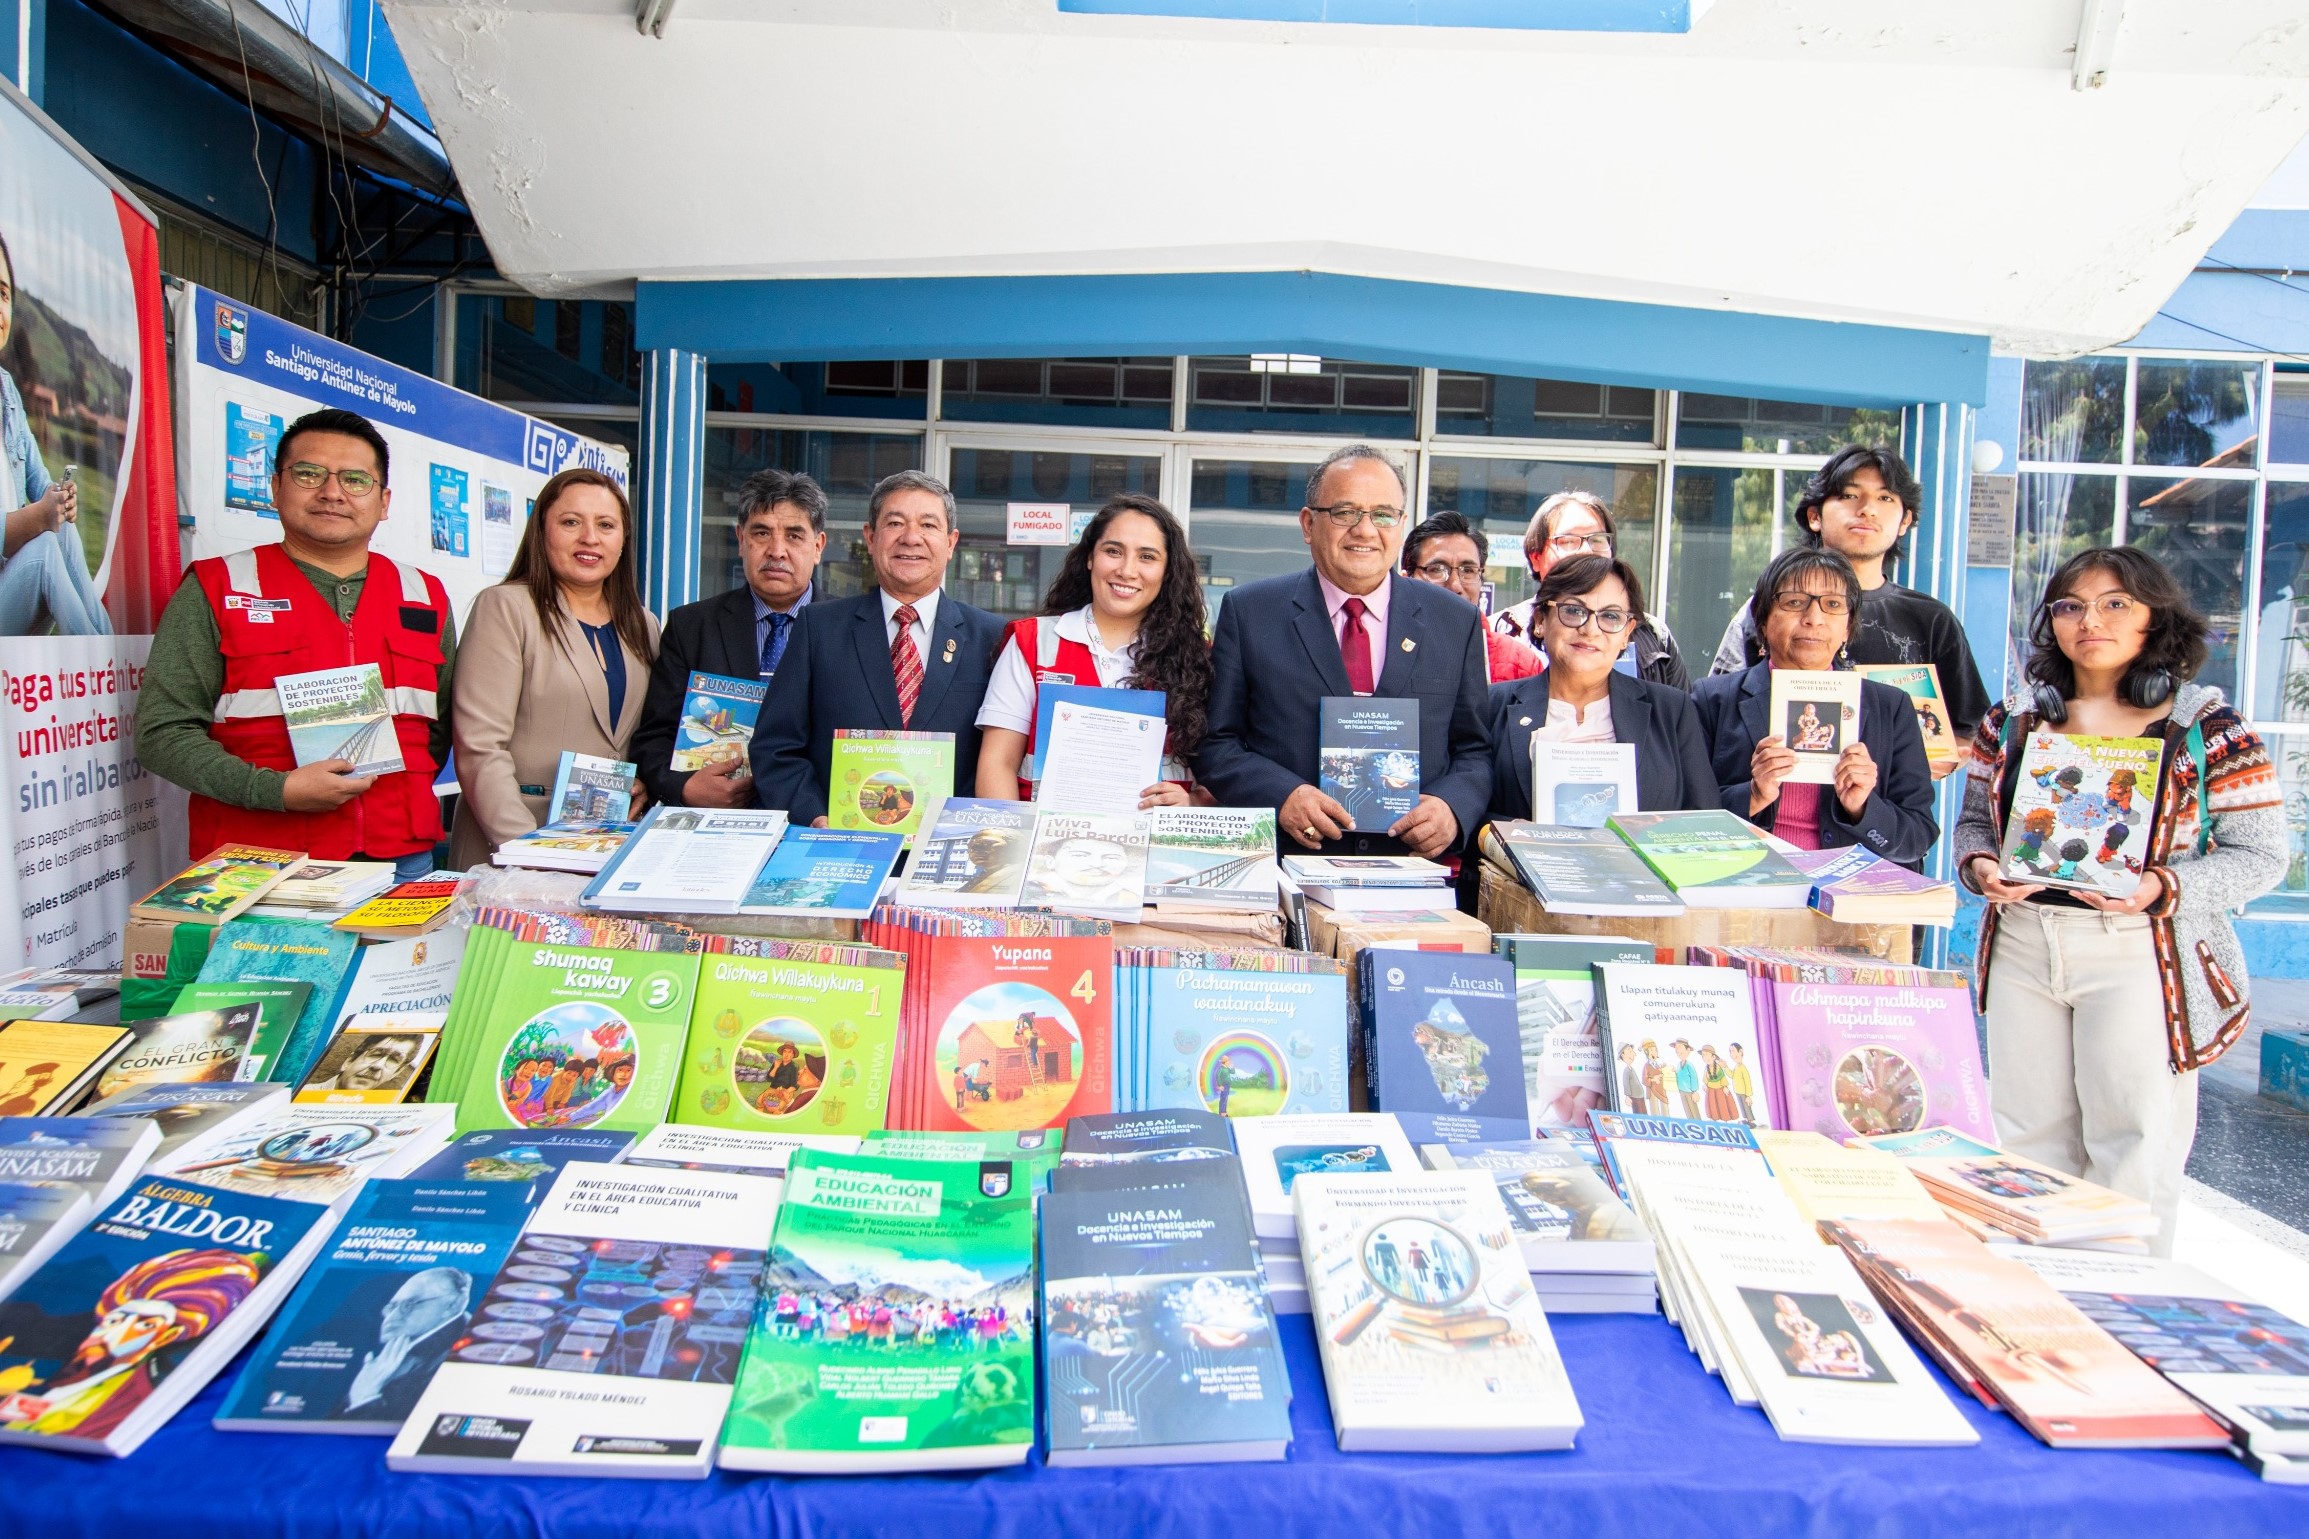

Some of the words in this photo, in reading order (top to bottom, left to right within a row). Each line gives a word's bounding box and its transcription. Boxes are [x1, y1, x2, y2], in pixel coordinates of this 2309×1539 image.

[291, 343, 353, 380] Universidad
[356, 368, 397, 396] Nacional
[266, 349, 319, 382] Santiago
[321, 371, 365, 398] Antúnez
[367, 387, 381, 401] de
[382, 392, 417, 415] Mayolo
[1023, 511, 1053, 519] LOCAL
[1013, 521, 1063, 530] FUMIGADO
[2, 669, 53, 713] Paga
[58, 667, 87, 700] tus
[283, 674, 358, 692] ELABORACIÓN
[706, 677, 767, 698] UNASAM
[286, 689, 300, 700] DE
[303, 683, 364, 697] PROYECTOS
[287, 693, 359, 709] SOSTENIBLES
[841, 743, 874, 754] Qichwa
[2072, 745, 2091, 755] LA
[2095, 747, 2148, 760] NUEVA
[2033, 754, 2063, 766] ERA
[2065, 759, 2092, 768] DEL
[2096, 757, 2147, 771] SUEÑO
[20, 770, 58, 813] sin
[63, 764, 73, 802] ir
[75, 759, 93, 798] al
[580, 775, 625, 790] UNASAM
[954, 814, 1022, 828] UNASAM
[1047, 817, 1092, 830] ¡Viva
[1158, 812, 1246, 822] ELABORACIÓN
[1178, 820, 1251, 829] PROYECTOS
[38, 827, 68, 849] pagos
[1044, 827, 1083, 840] Luis
[1085, 831, 1147, 845] Pardo!
[1157, 826, 1243, 836] SOSTENIBLES
[38, 856, 53, 873] de
[55, 852, 68, 869] los
[812, 866, 873, 874] DERECHO
[809, 871, 871, 880] ECONÓMICO
[60, 885, 78, 905] tasas
[78, 878, 93, 895] que
[95, 868, 121, 890] puedes
[398, 898, 449, 906] CIENCIA
[37, 919, 78, 949] Matrícula
[85, 930, 118, 957] admisión
[232, 940, 269, 952] Cultura
[271, 944, 279, 955] y
[281, 943, 330, 956] Ambiente
[532, 949, 615, 975] Shumaq
[991, 944, 1053, 966] Yupana
[1618, 952, 1641, 960] CAFAE
[564, 970, 635, 996] kaway
[714, 962, 769, 985] Qichwa
[771, 967, 865, 995] Willakuykuna
[1175, 968, 1316, 996] Pachamamawan
[1448, 971, 1505, 992] Áncash
[648, 978, 671, 1006] 3
[1069, 969, 1097, 1005] 4
[1620, 985, 1652, 996] Llapan
[1654, 986, 1698, 998] titulakuy
[1701, 988, 1736, 999] munaq
[361, 993, 452, 1014] APRECIACIÓN
[864, 984, 882, 1017] 1
[1193, 994, 1297, 1019] waatanakuy
[1643, 1000, 1716, 1010] comunerukuna
[1790, 984, 1871, 1014] Ashmapa
[1874, 989, 1947, 1015] mallkipa
[1644, 1012, 1718, 1025] qatiyaananpaq
[1826, 1008, 1916, 1030] hapinkuna
[143, 1046, 168, 1057] EL
[172, 1038, 225, 1054] GRAN
[1552, 1038, 1560, 1047] El
[1560, 1038, 1589, 1048] Derecho
[119, 1047, 237, 1070] CONFLICTO
[1091, 1026, 1106, 1095] Qichwa
[1552, 1051, 1562, 1059] en
[1562, 1050, 1571, 1059] el
[1571, 1050, 1600, 1060] Derecho
[865, 1041, 888, 1111] QICHWA
[1328, 1044, 1344, 1112] QICHWA
[325, 1093, 366, 1103] Alfredo
[1959, 1057, 1981, 1126] QICHWA
[1089, 1129, 1131, 1137] Docencia
[1137, 1124, 1202, 1135] Investigación
[1114, 1118, 1176, 1129] UNASAM
[542, 1134, 614, 1145] Áncash
[667, 1132, 743, 1144] INVESTIGACIÓN
[743, 1138, 805, 1148] CUALITATIVA
[1100, 1132, 1113, 1140] en
[1113, 1131, 1150, 1139] Nuevos
[1150, 1127, 1191, 1137] Tiempos
[1626, 1118, 1749, 1146] UNASAM
[661, 1137, 677, 1145] EN
[691, 1138, 719, 1148] ÁREA
[719, 1141, 774, 1152] EDUCATIVA
[664, 1142, 705, 1152] CLÍNICA
[879, 1142, 981, 1153] EDUCACIÓN
[1476, 1157, 1571, 1170] UNASAM
[1647, 1157, 1701, 1170] HISTORIA
[137, 1180, 215, 1209] ÁLGEBRA
[413, 1188, 437, 1196] Danilo
[438, 1188, 466, 1197] Sánchez
[575, 1178, 666, 1195] INVESTIGACIÓN
[667, 1184, 740, 1201] CUALITATIVA
[814, 1176, 934, 1199] EDUCACIÓN
[1326, 1187, 1386, 1196] UNIVERSIDAD
[569, 1190, 591, 1201] EN
[591, 1191, 607, 1202] EL
[606, 1189, 637, 1205] ÁREA
[637, 1195, 703, 1210] EDUCATIVA
[809, 1192, 927, 1215] AMBIENTAL
[1335, 1200, 1388, 1208] FORMANDO
[1388, 1199, 1468, 1208] INVESTIGADORES
[1674, 1195, 1729, 1210] HISTORIA
[411, 1204, 436, 1212] Danilo
[437, 1205, 465, 1214] Sánchez
[563, 1203, 573, 1212] Y
[572, 1201, 621, 1216] CLÍNICA
[1107, 1208, 1183, 1223] UNASAM
[805, 1210, 861, 1224] PRÁCTICAS
[862, 1216, 933, 1230] PEDAGÓGICAS
[1077, 1222, 1130, 1235] Docencia
[1139, 1218, 1215, 1232] Investigación
[106, 1225, 151, 1241] EDICIÓN
[347, 1226, 418, 1239] SANTIAGO
[804, 1222, 825, 1232] DEL
[825, 1223, 867, 1236] PARQUE
[867, 1226, 918, 1238] NACIONAL
[918, 1228, 980, 1239] HUASCARÁN
[1091, 1233, 1107, 1244] en
[1108, 1230, 1152, 1242] Nuevos
[1152, 1229, 1204, 1242] Tiempos
[1692, 1224, 1749, 1238] HISTORIA
[339, 1236, 404, 1250] ANTÚNEZ
[404, 1240, 427, 1251] DE
[425, 1241, 487, 1254] MAYOLO
[332, 1250, 365, 1262] Genio,
[364, 1250, 400, 1263] fervor
[407, 1252, 438, 1264] tesón
[1719, 1252, 1779, 1266] HISTORIA
[1733, 1263, 1815, 1276] OBSTETRICIA
[1227, 1365, 1258, 1375] Guerrero
[508, 1384, 558, 1399] ROSARIO
[558, 1389, 601, 1402] YSLADO
[601, 1390, 648, 1406] MÉNDEZ
[835, 1390, 873, 1400] ALBERTO
